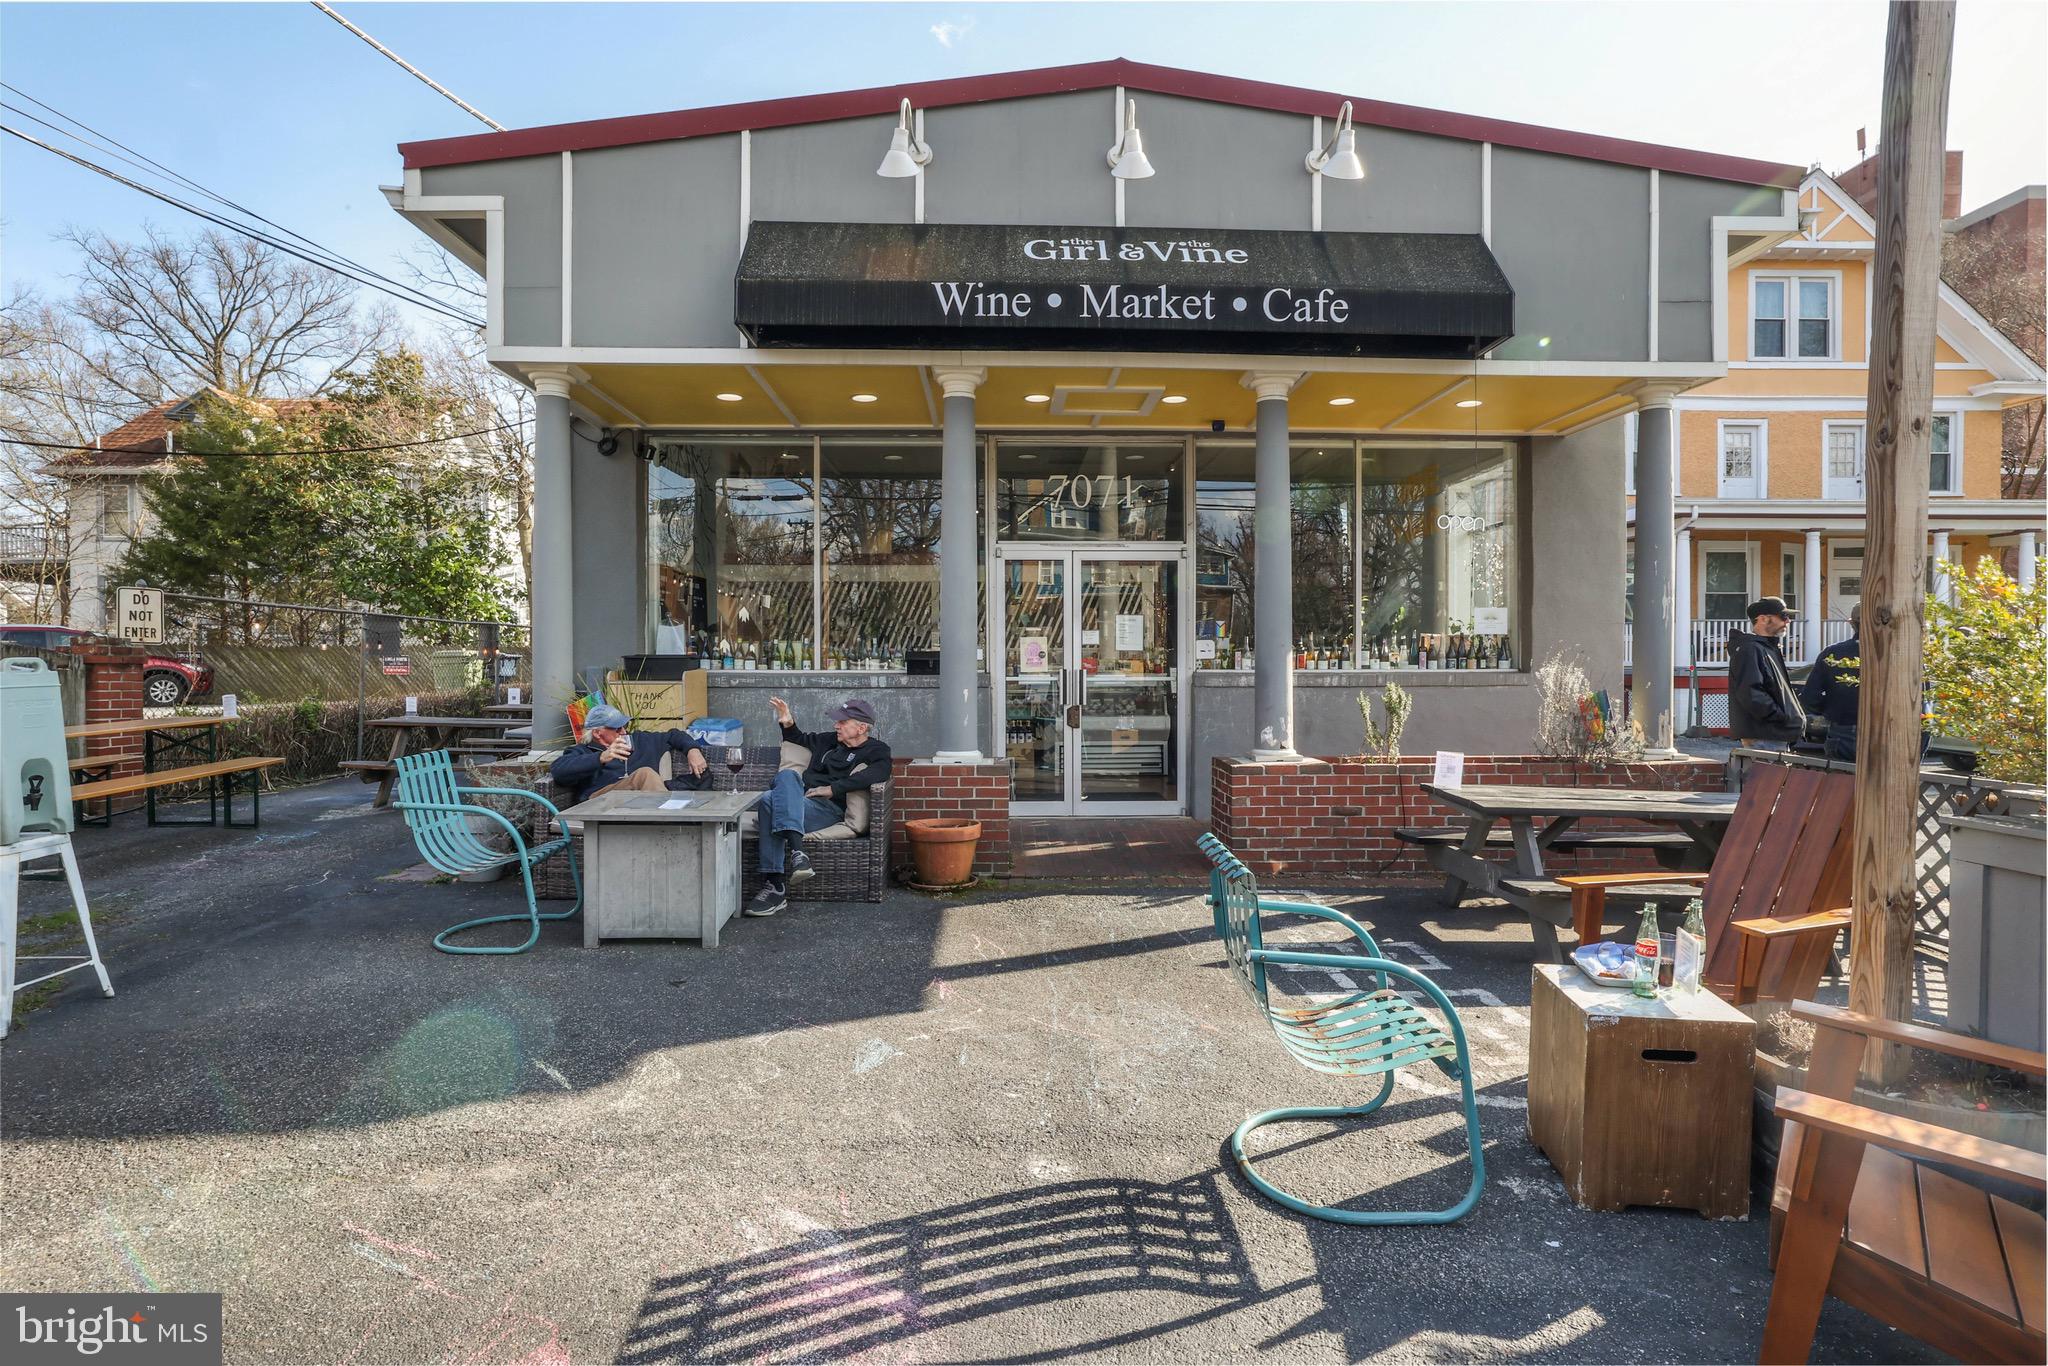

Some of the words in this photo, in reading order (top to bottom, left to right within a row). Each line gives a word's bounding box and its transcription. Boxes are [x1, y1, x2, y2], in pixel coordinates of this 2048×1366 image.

[1069, 237, 1092, 246] the
[1187, 239, 1211, 248] the
[1023, 239, 1111, 261] Girl
[931, 282, 1031, 317] Wine
[1079, 284, 1215, 321] Market
[1262, 287, 1349, 323] Cafe
[1047, 474, 1135, 508] 7071
[1437, 514, 1485, 533] open
[132, 593, 150, 605] DO
[129, 610, 153, 621] NOT
[124, 626, 157, 638] ENTER
[630, 691, 664, 700] THANK
[635, 702, 657, 710] YOU
